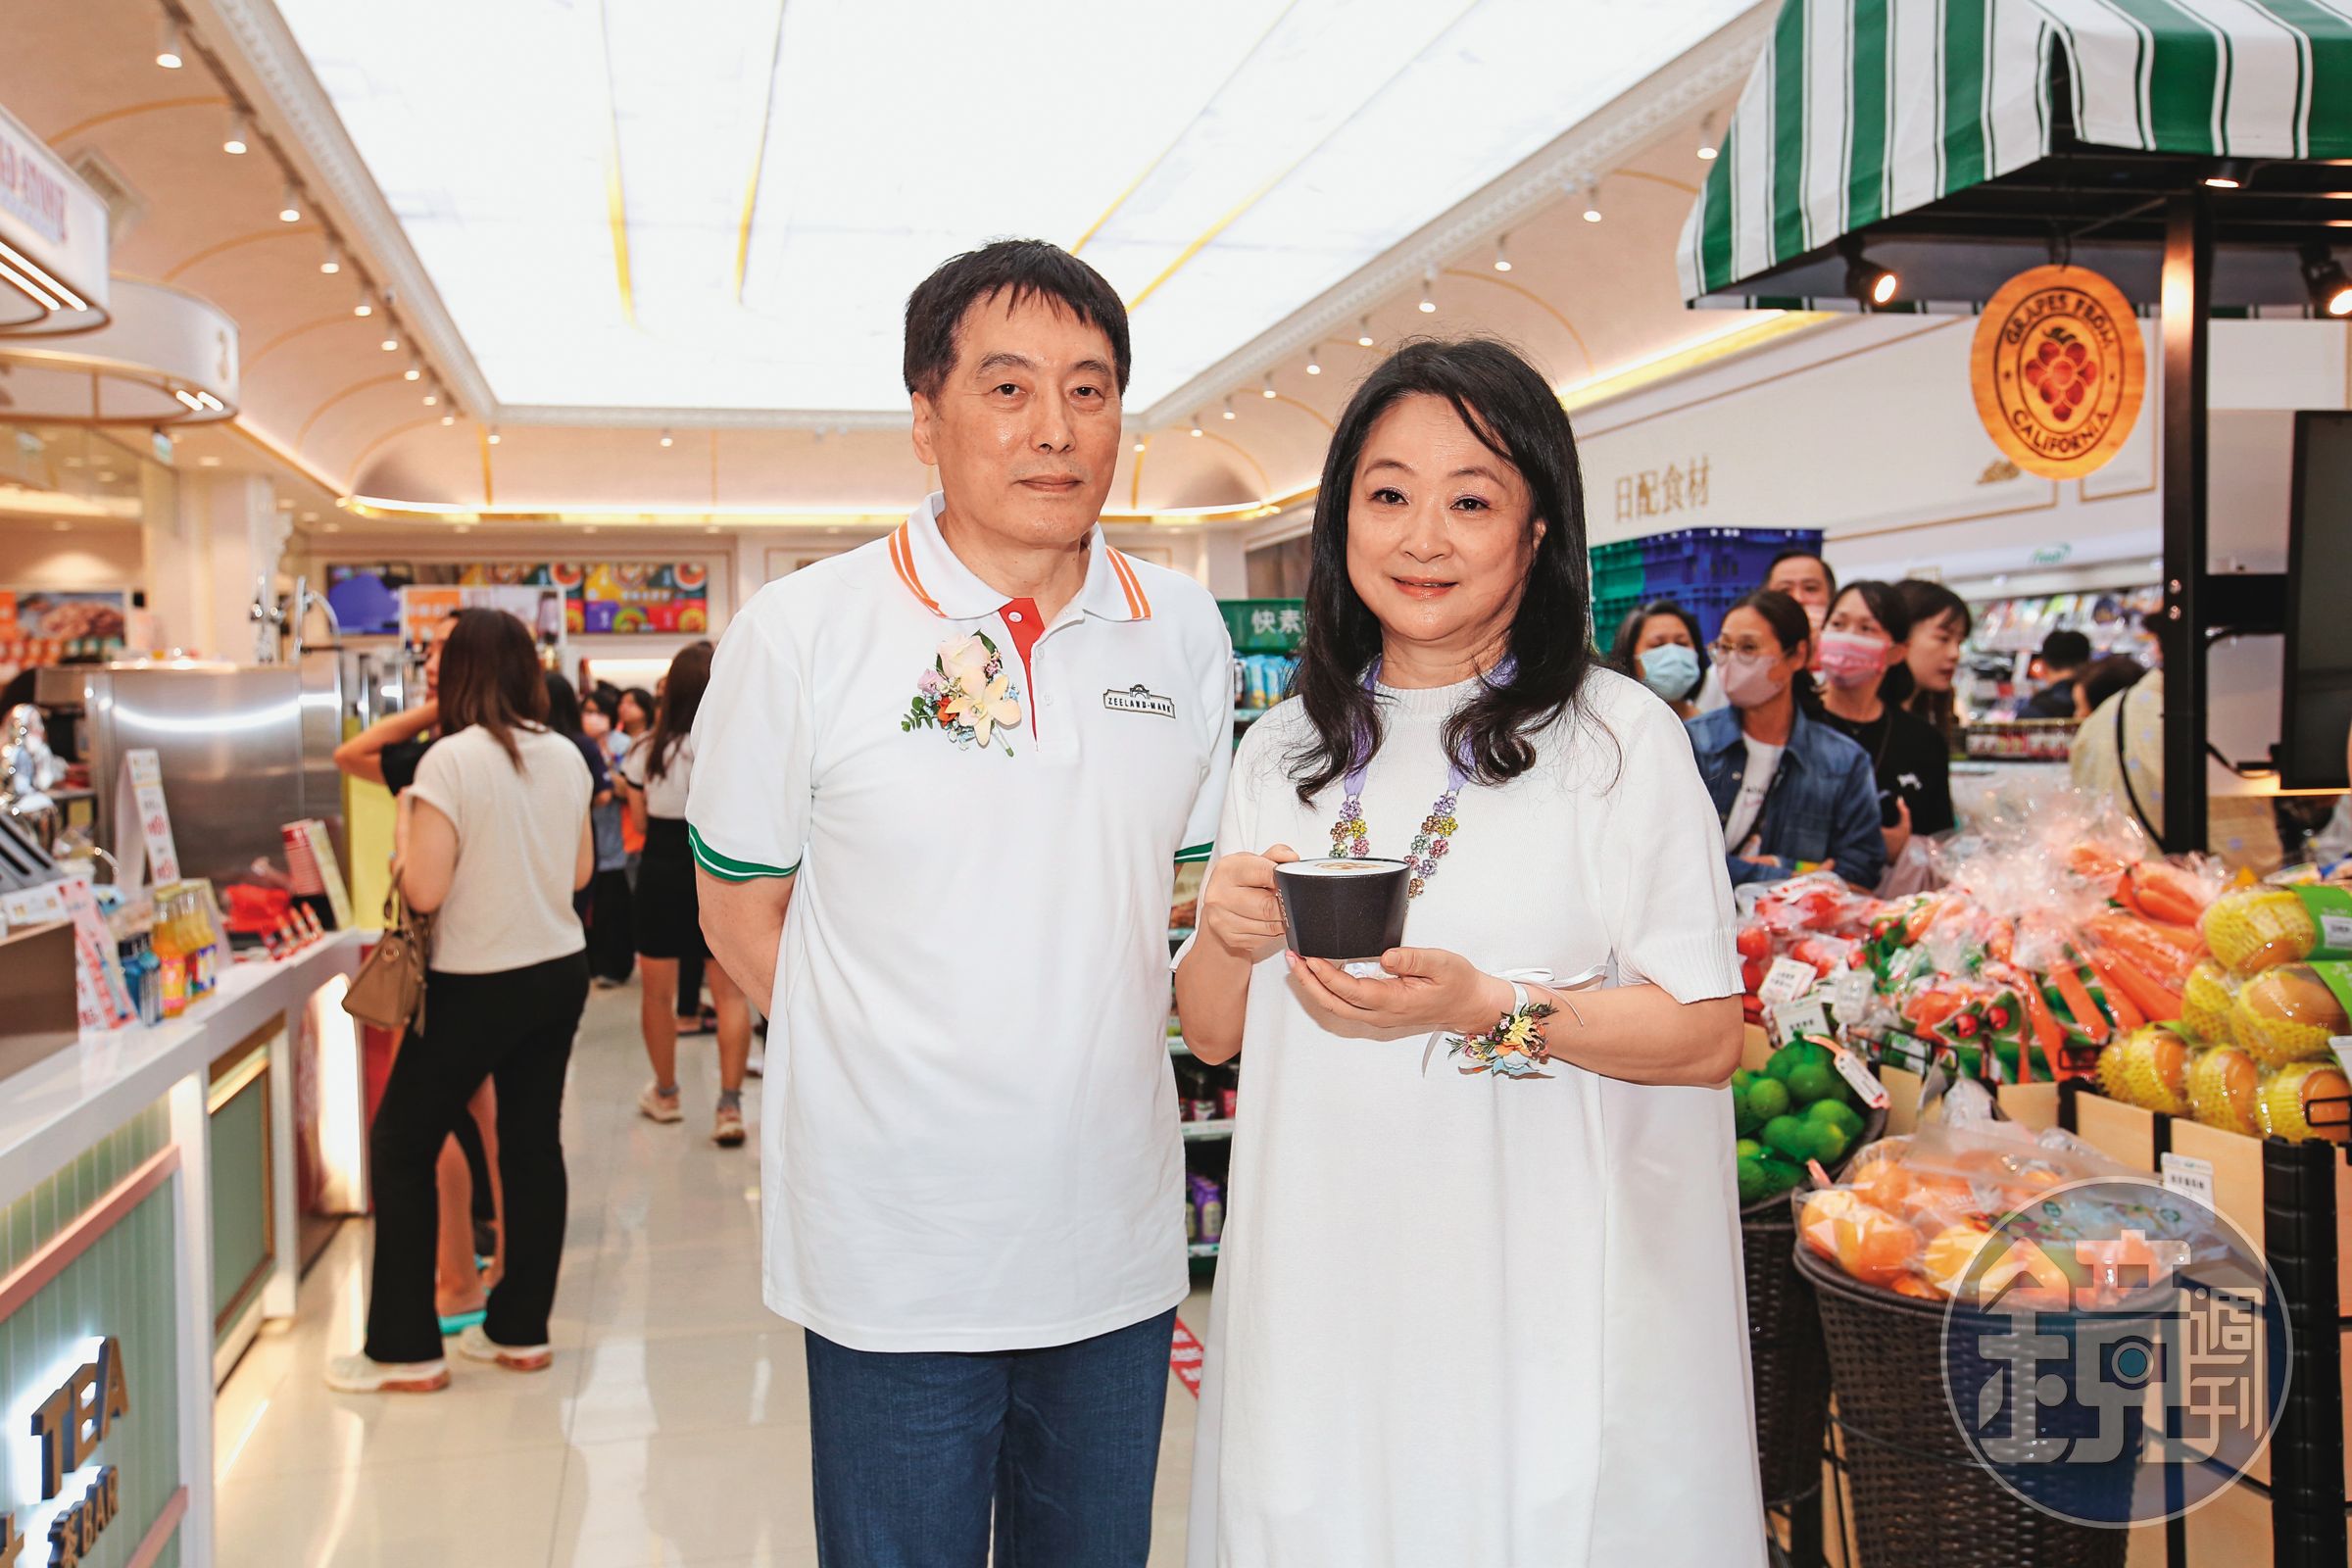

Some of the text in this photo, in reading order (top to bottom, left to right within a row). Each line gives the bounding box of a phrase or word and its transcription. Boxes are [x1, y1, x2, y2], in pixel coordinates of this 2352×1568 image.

[2006, 295, 2114, 349] GRAPES FROM
[2012, 410, 2108, 453] CALIFORNIA
[1615, 454, 1708, 522] 日配食材
[31, 1336, 129, 1500] TEA
